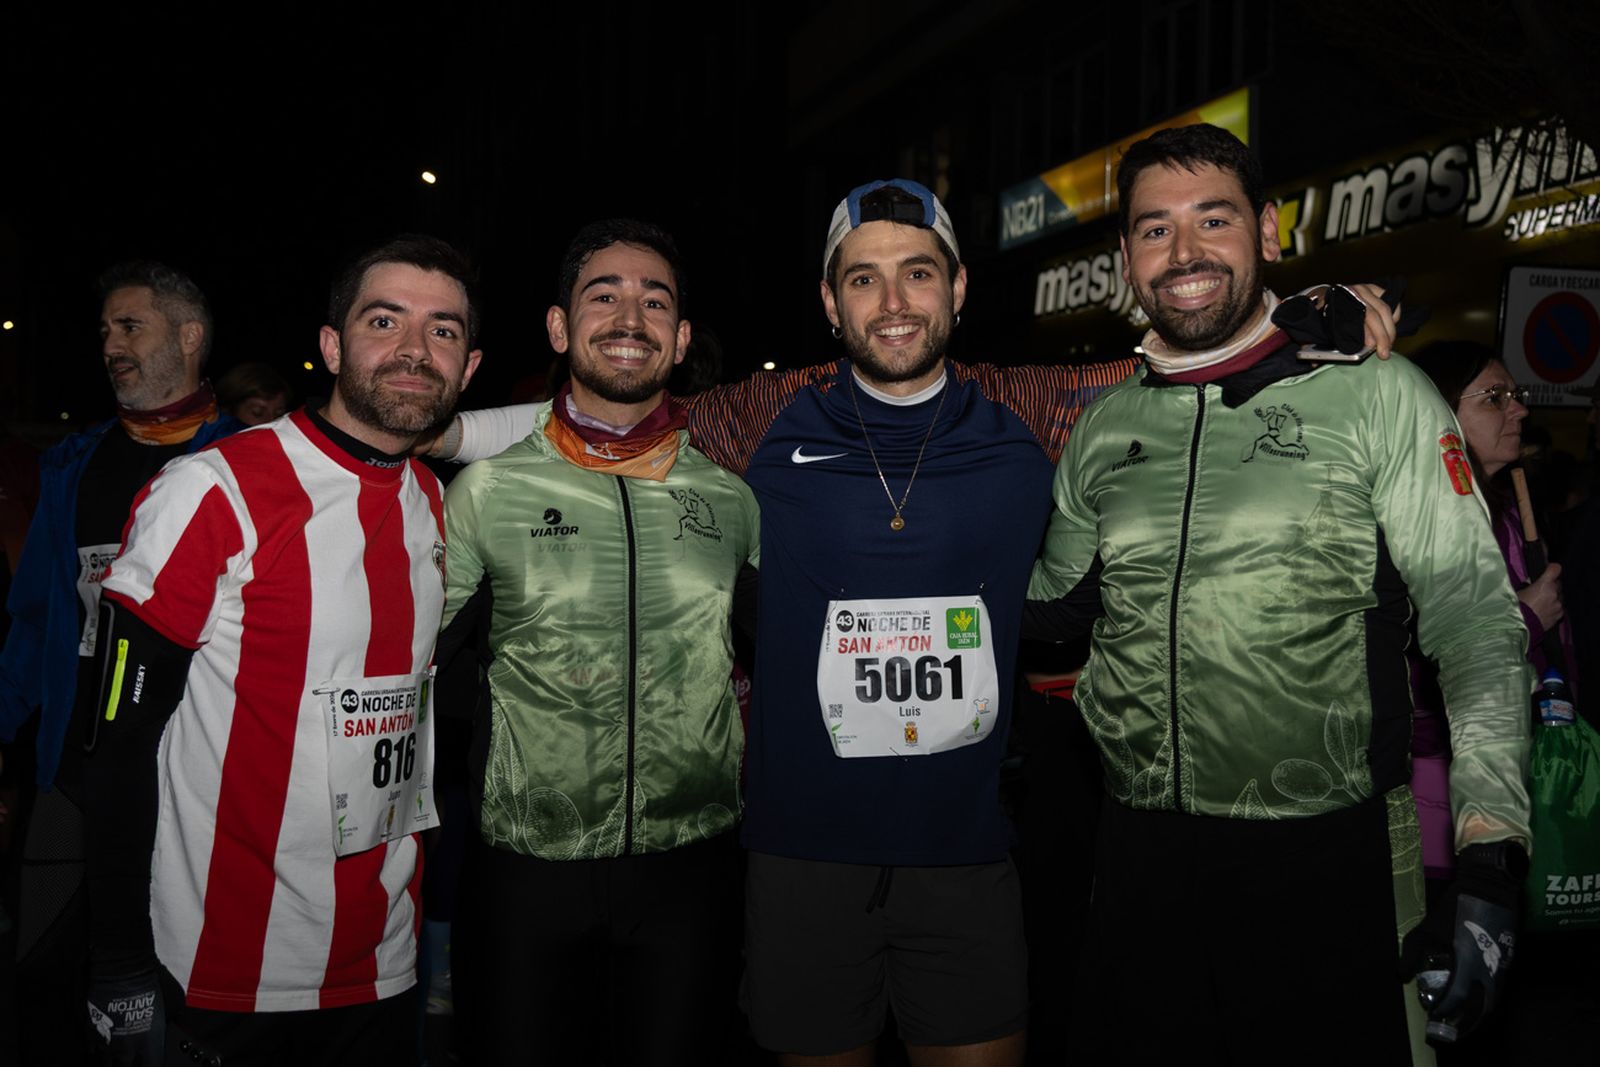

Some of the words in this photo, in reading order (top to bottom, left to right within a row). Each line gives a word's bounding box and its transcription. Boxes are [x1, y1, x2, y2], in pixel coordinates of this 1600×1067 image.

[1003, 194, 1045, 241] NB21
[1529, 274, 1558, 288] CARGA
[1560, 275, 1566, 288] Y
[365, 457, 404, 469] Jom
[1112, 455, 1149, 472] VIATOR
[530, 526, 579, 538] VIATOR
[837, 615, 853, 627] 43
[857, 617, 907, 633] NOCHE
[912, 616, 931, 631] DE
[837, 637, 871, 654] SAN
[855, 654, 963, 704] 5061
[362, 694, 404, 713] NOCHE
[405, 692, 417, 708] DE
[899, 706, 921, 717] Luis
[344, 717, 376, 737] SAN
[379, 709, 415, 734] ANTÓN
[373, 732, 417, 788] 816
[107, 992, 156, 1013] ANTÓN
[124, 1006, 154, 1022] SAN
